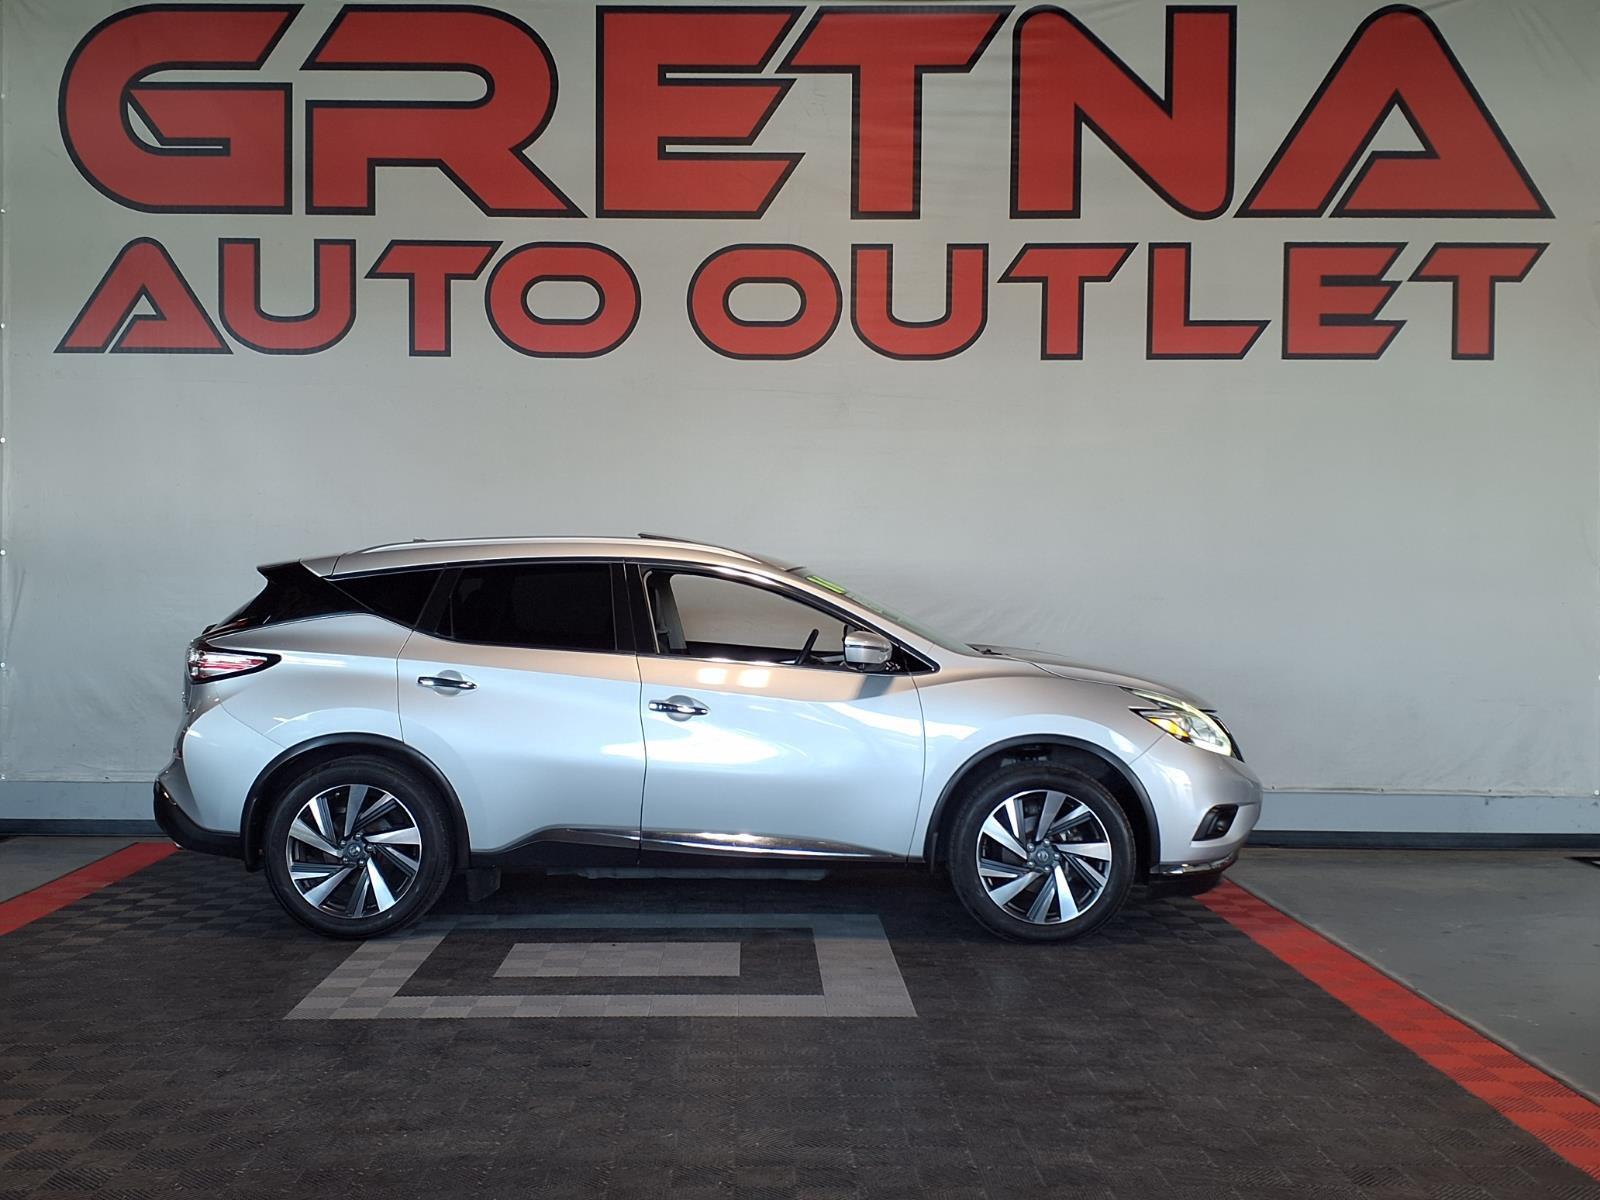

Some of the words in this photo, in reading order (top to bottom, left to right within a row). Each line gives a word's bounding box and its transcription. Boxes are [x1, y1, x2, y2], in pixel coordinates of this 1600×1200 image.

[58, 3, 1555, 220] GRETNA
[54, 237, 641, 358] AUTO
[687, 242, 1550, 360] OUTLET
